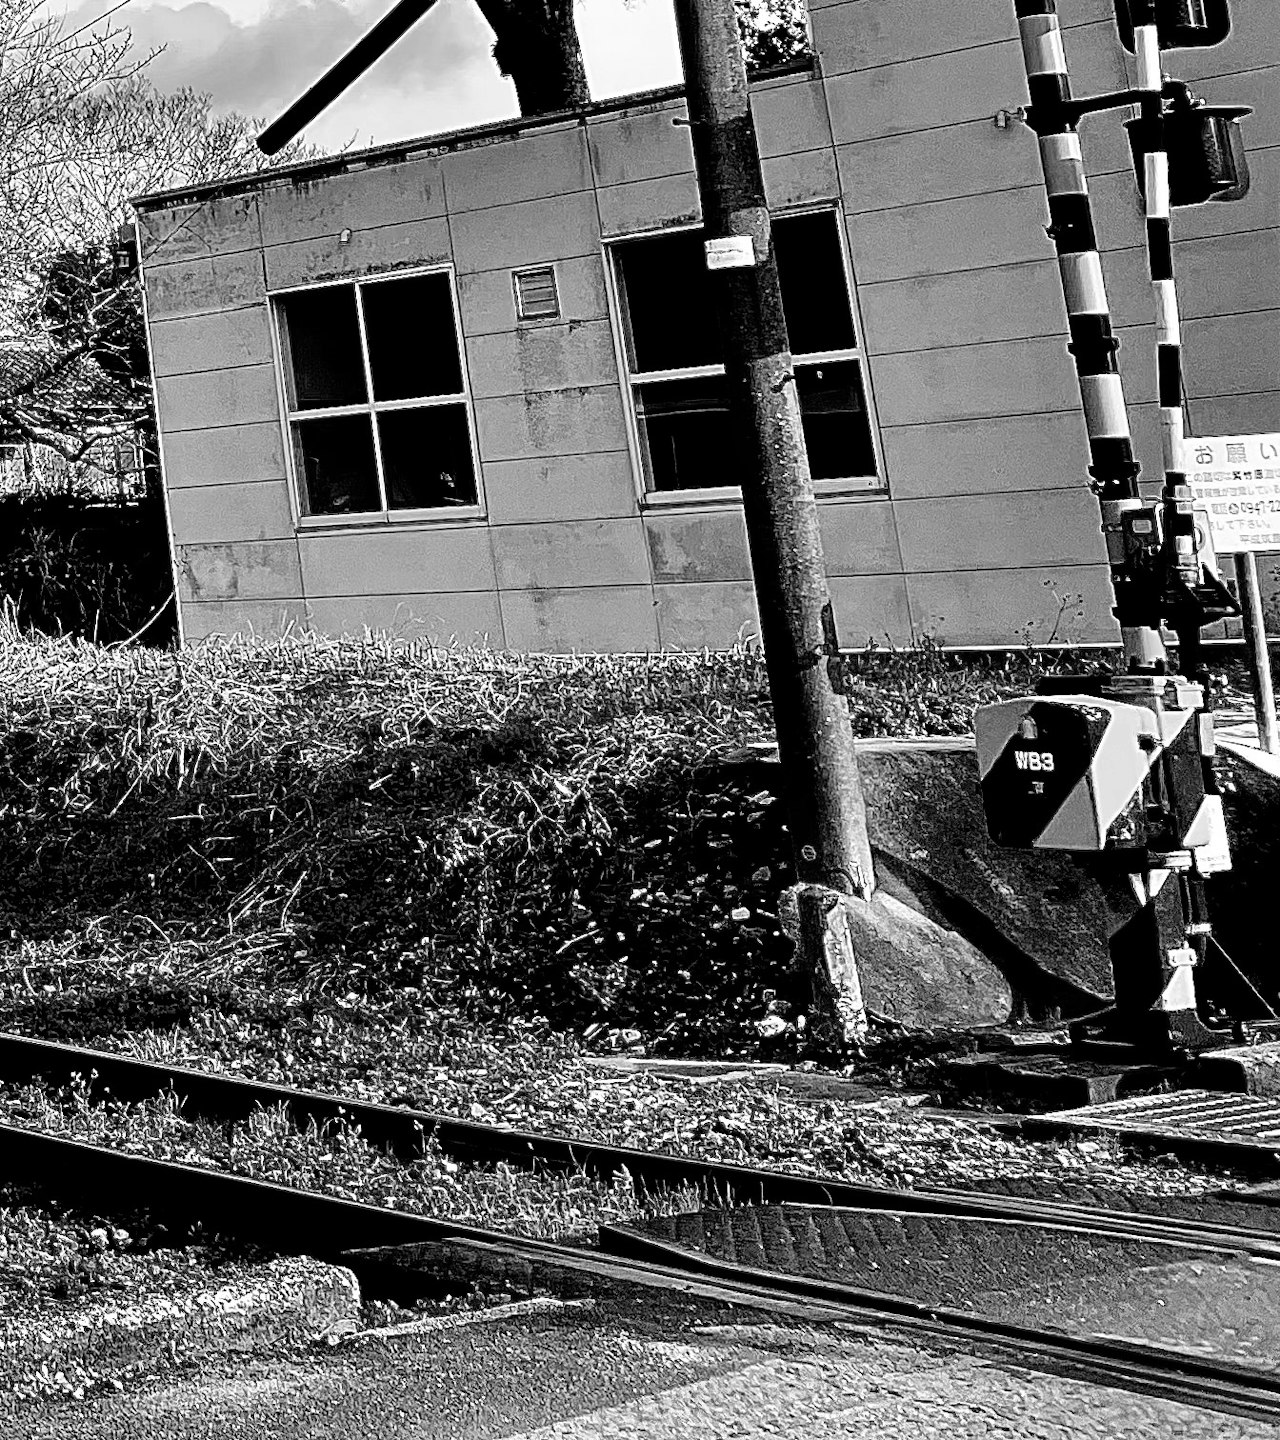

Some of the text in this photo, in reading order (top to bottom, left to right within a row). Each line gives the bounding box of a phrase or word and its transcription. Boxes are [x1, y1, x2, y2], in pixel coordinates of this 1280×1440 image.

[1194, 442, 1278, 464] お願い
[1014, 750, 1055, 772] WB3
